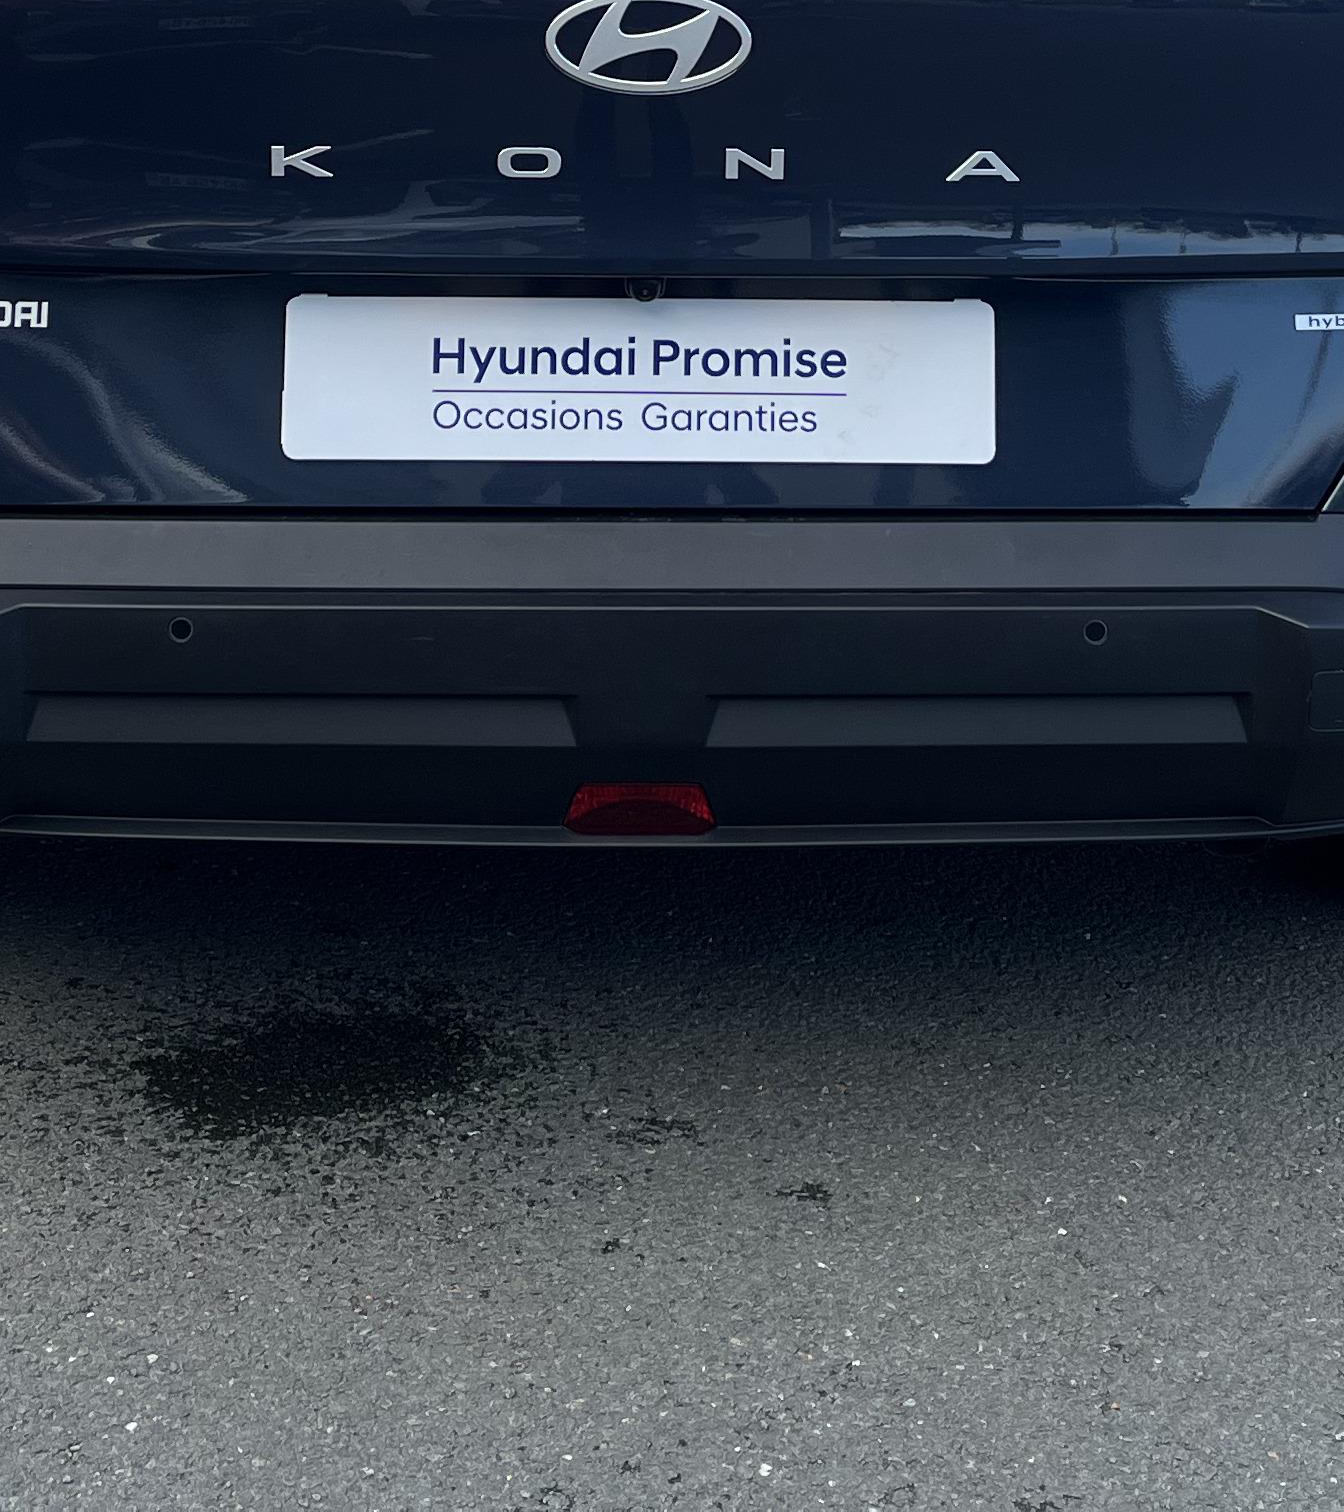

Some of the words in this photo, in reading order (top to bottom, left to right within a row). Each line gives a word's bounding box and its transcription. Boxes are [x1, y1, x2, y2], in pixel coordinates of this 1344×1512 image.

[270, 144, 1022, 182] KONA
[432, 336, 636, 385] Hyundai
[652, 337, 848, 379] Promise
[432, 399, 624, 432] Occasions
[640, 401, 819, 434] Garanties
